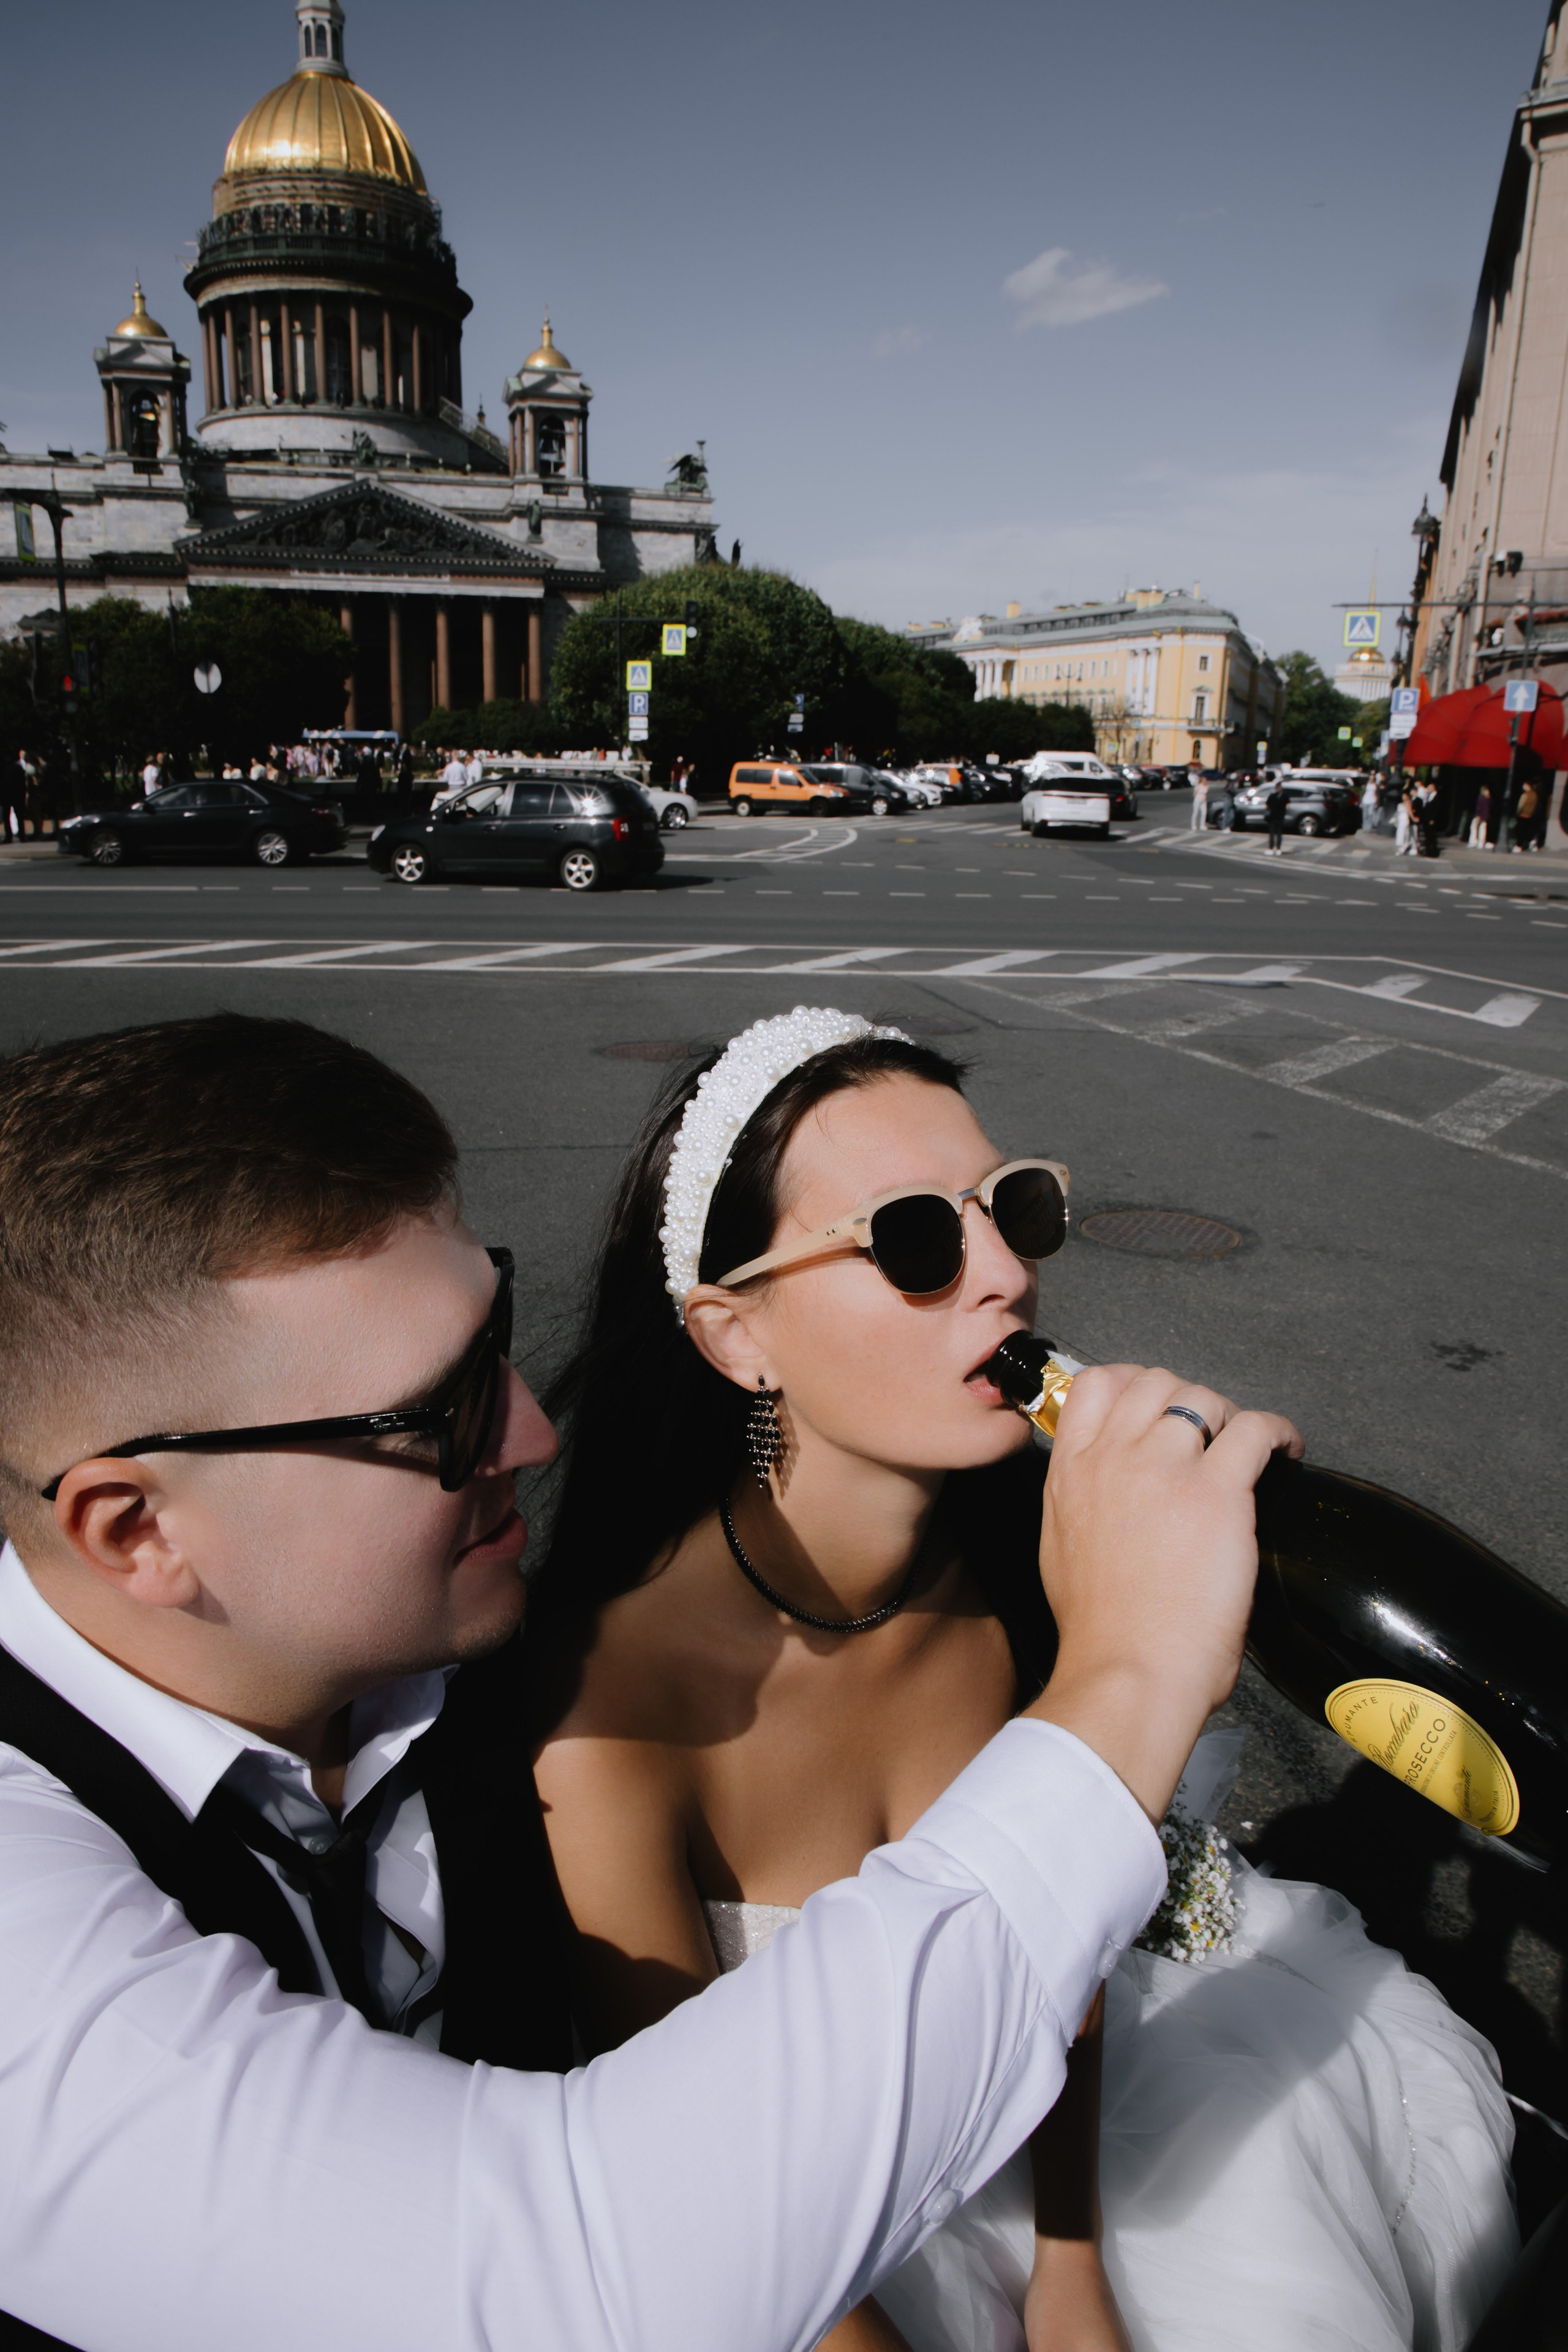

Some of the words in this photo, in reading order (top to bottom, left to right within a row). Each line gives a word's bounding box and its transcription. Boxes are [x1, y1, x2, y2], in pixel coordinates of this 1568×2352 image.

[634, 695, 645, 712] P
[1398, 691, 1414, 710] P
[1344, 1696, 1378, 1743] SPUMANTE
[1404, 1718, 1446, 1788] PROSECCO
[1436, 1730, 1458, 1760] CONTROLLATA
